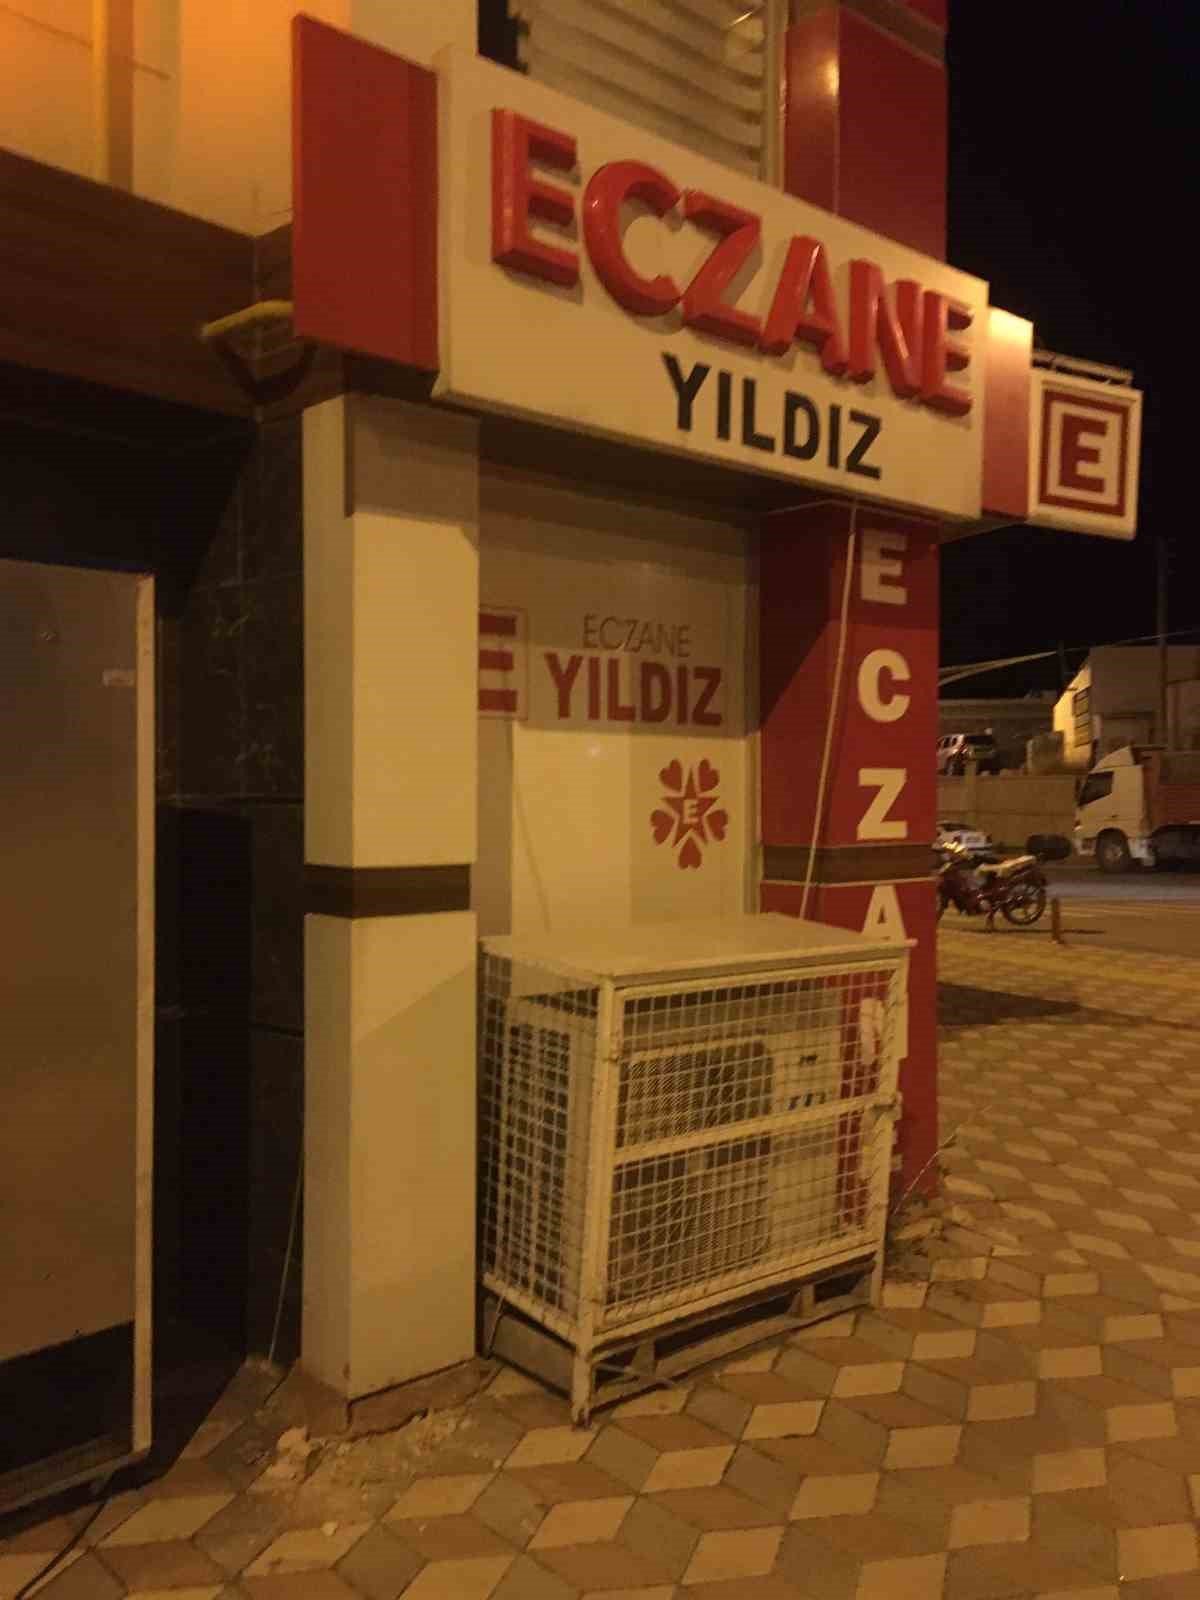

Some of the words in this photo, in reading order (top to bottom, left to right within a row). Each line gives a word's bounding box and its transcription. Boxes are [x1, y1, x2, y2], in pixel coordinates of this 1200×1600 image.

[491, 107, 973, 416] ECZANE
[661, 351, 881, 480] YILDIZ
[1059, 413, 1108, 493] E
[583, 614, 692, 658] ECZANE
[544, 653, 722, 726] YILDIZ
